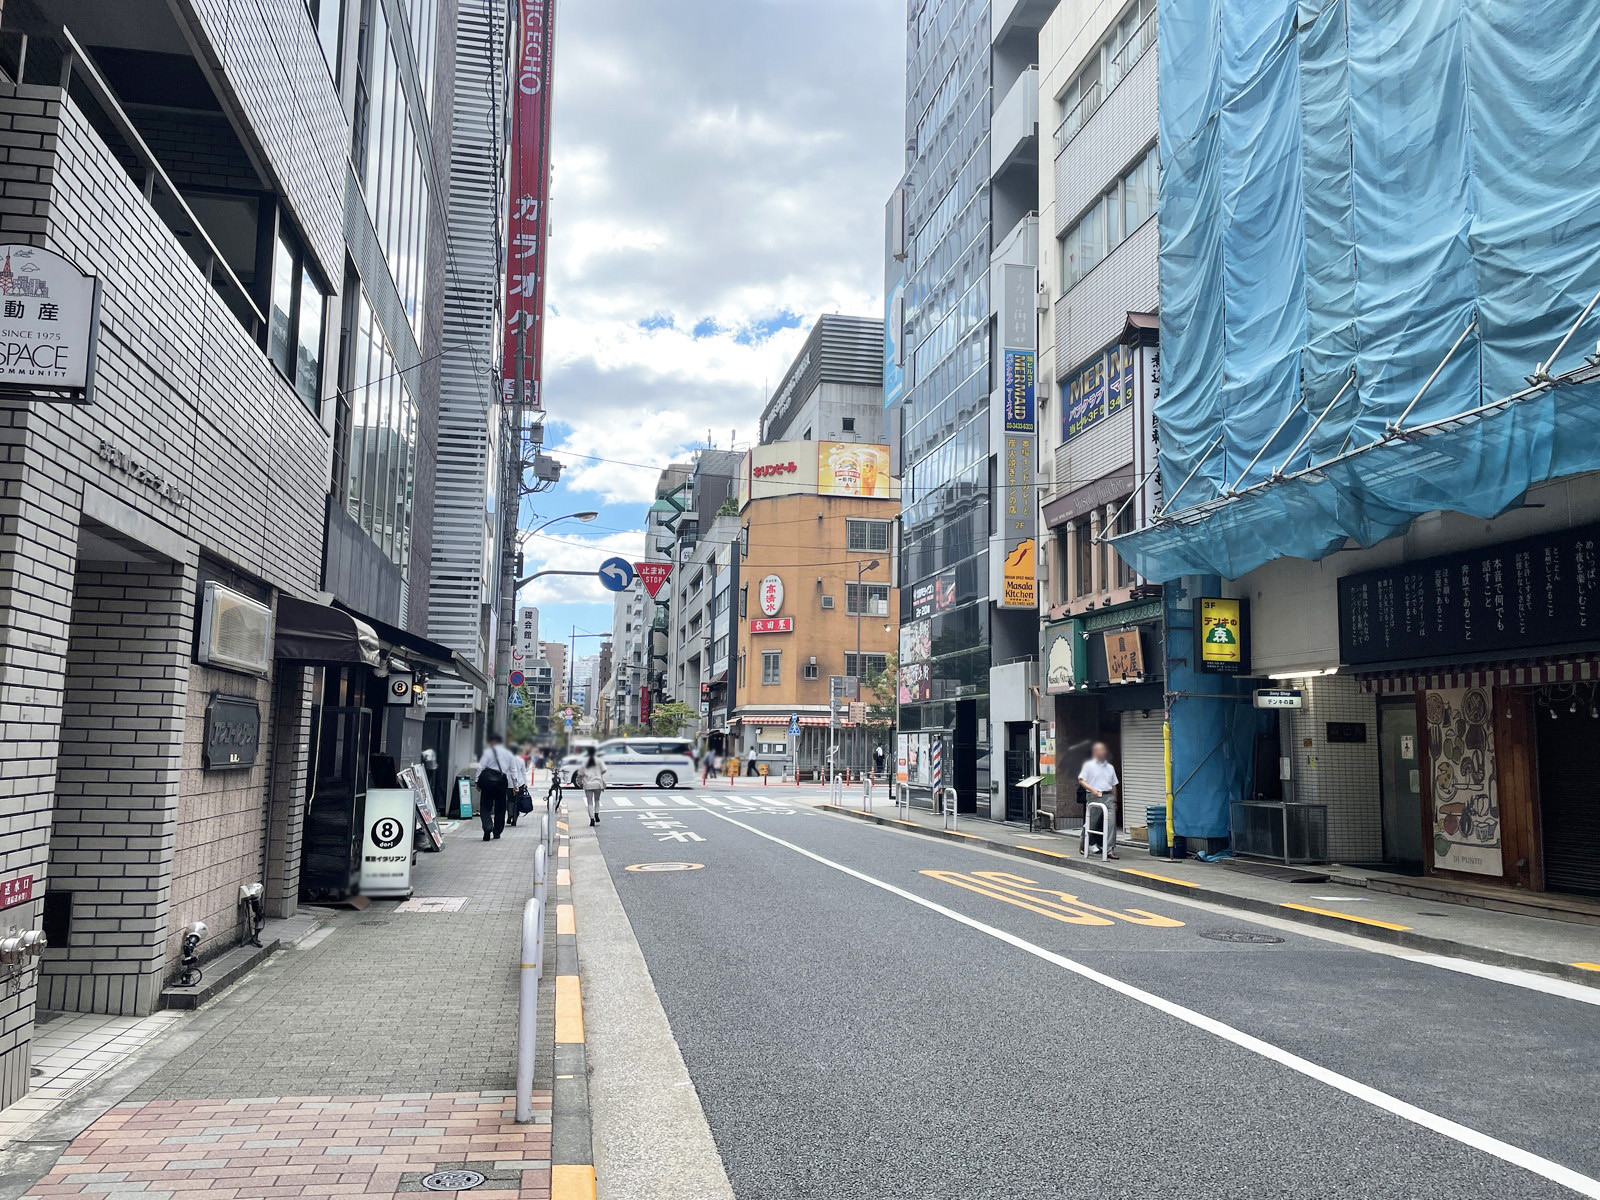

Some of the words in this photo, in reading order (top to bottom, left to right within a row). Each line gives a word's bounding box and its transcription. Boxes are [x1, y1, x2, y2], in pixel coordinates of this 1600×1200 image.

[525, 0, 543, 27] IG
[519, 31, 542, 95] ECHO
[507, 198, 543, 335] カラオケ
[4, 300, 59, 321] 動産
[2, 329, 33, 339] SINCE
[37, 332, 61, 341] 1975
[1014, 354, 1026, 420] MERMAID
[753, 461, 797, 478] キリンビール
[641, 566, 666, 575] 止まれ
[645, 576, 662, 584] STOP
[1007, 581, 1032, 590] Masala
[1482, 560, 1492, 607] 話すこと
[1575, 541, 1586, 627] 今夜を楽しむこと
[1005, 590, 1034, 599] Kitchen
[1493, 557, 1504, 631] 本音で何でも
[1204, 601, 1216, 609] 3F
[1204, 616, 1237, 627] デンキの
[1212, 626, 1229, 643] 森
[381, 822, 393, 838] 8
[1461, 856, 1483, 866] PUNTO
